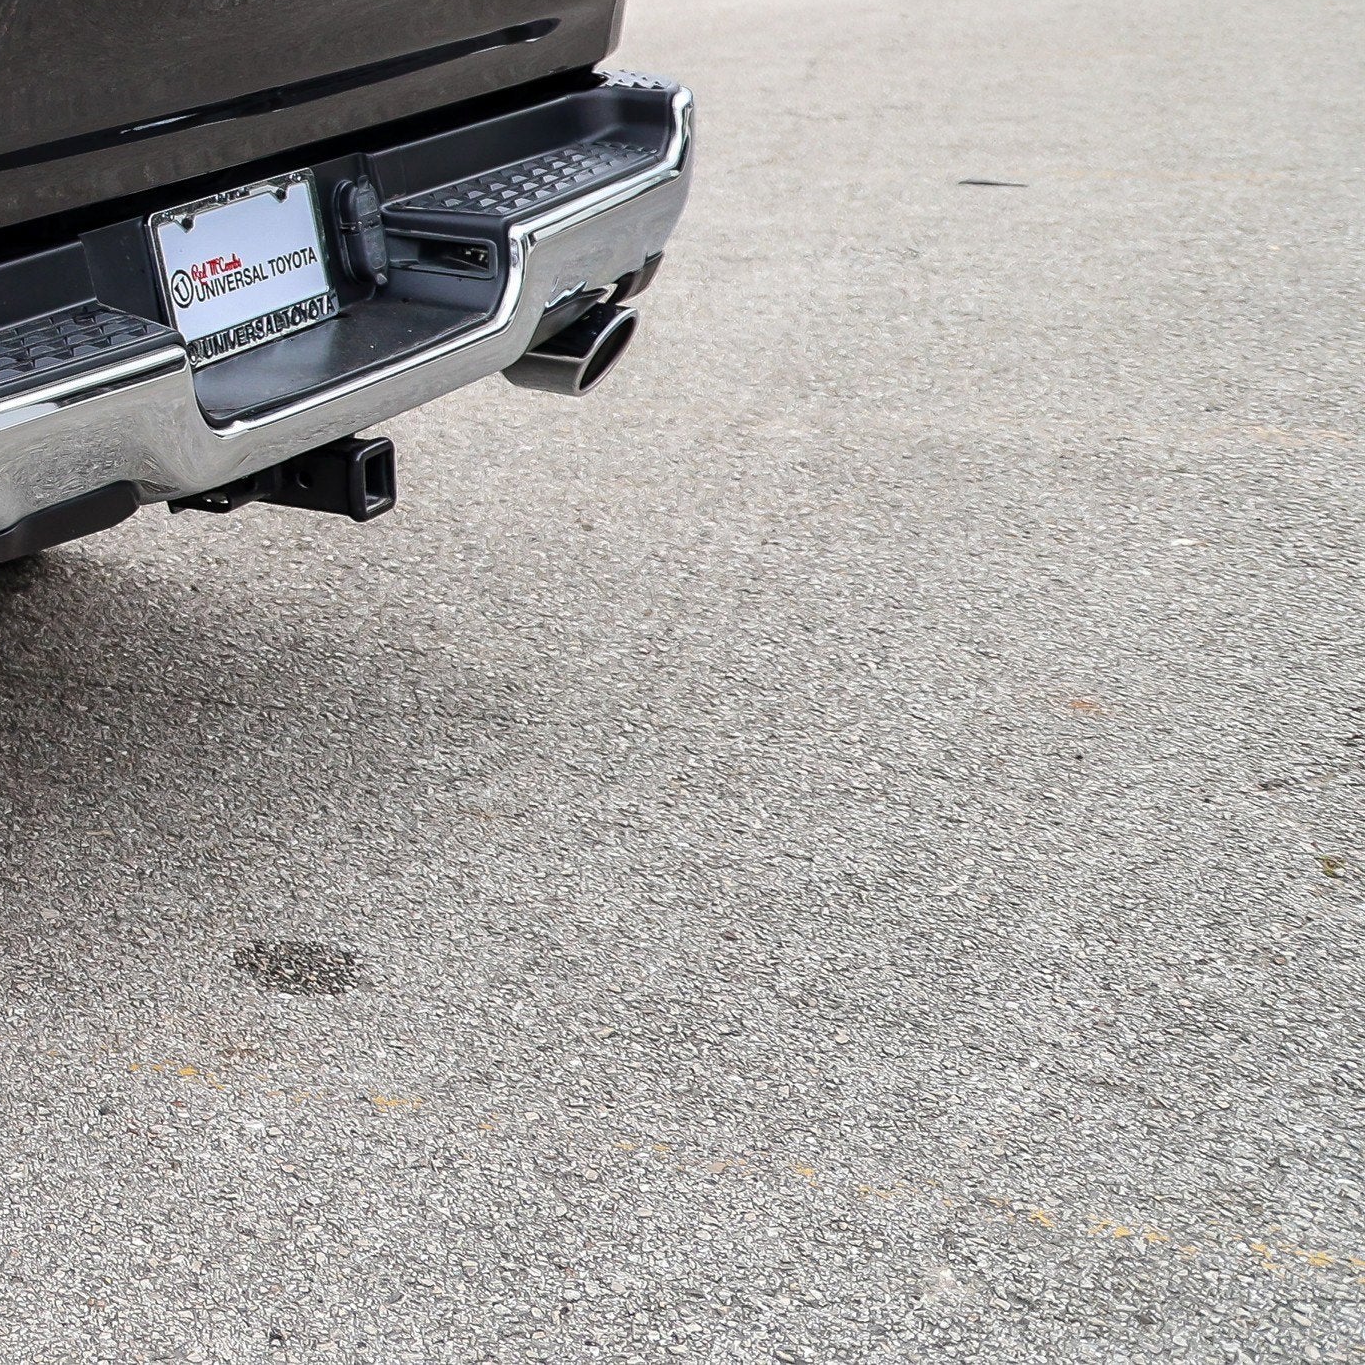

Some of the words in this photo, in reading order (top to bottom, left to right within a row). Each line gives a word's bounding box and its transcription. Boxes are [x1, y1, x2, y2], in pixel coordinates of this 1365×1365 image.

[194, 262, 269, 303] UNIVERSAL
[268, 246, 318, 277] TOYOTA
[203, 311, 283, 360] UNIVERSAL
[282, 294, 337, 327] TOYOTA
